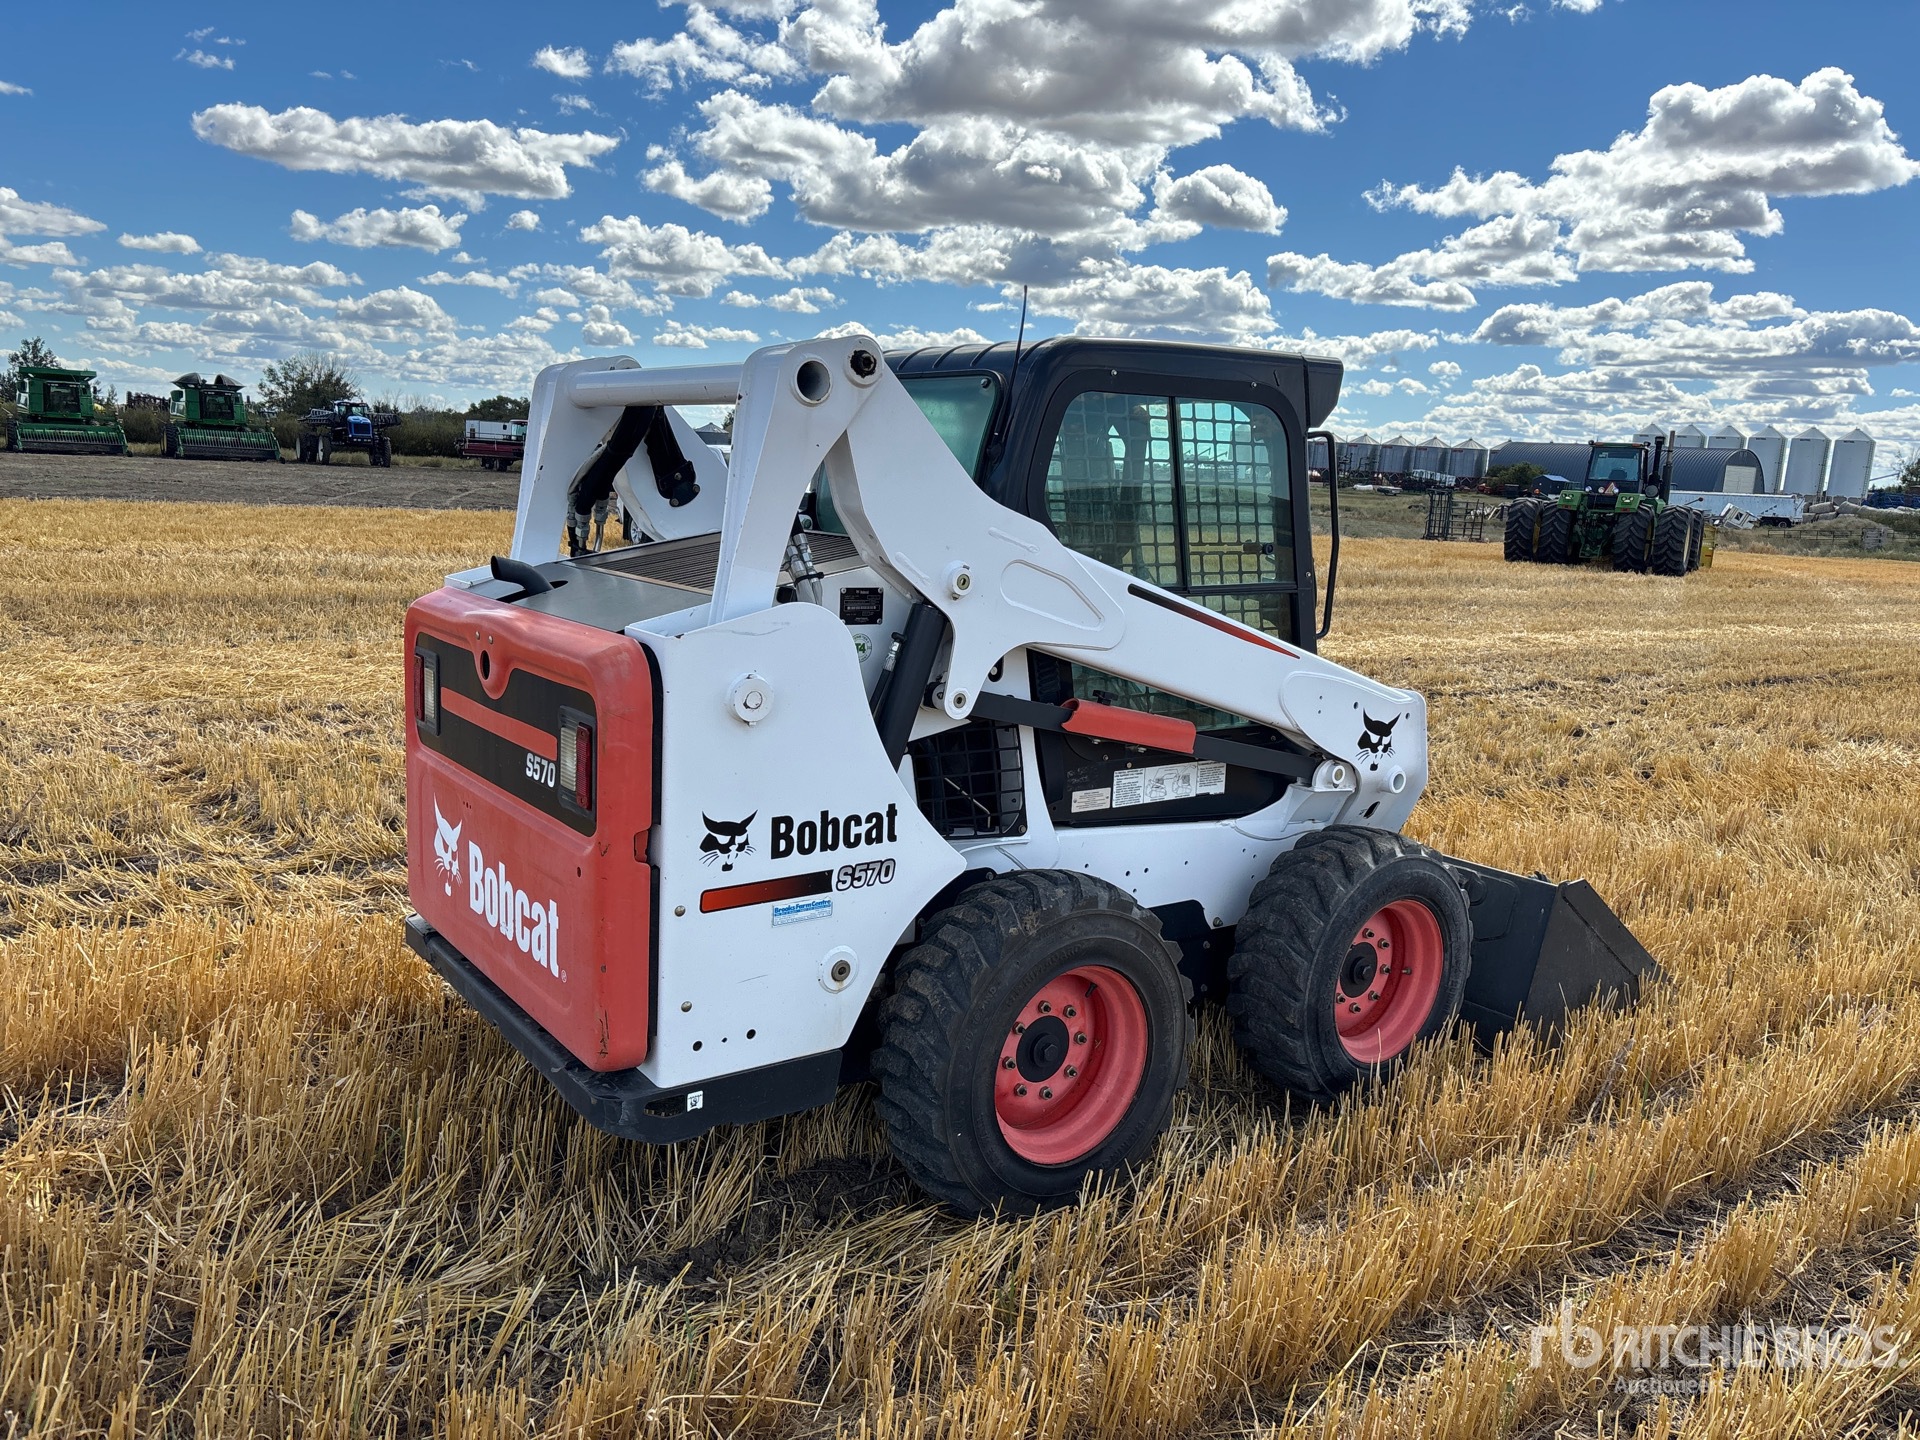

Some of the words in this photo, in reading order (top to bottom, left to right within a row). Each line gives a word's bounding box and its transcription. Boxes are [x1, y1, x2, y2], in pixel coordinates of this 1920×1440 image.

[526, 753, 556, 788] S570
[771, 803, 898, 860] Bobcat
[836, 858, 896, 891] S570
[469, 840, 559, 978] Bobcat
